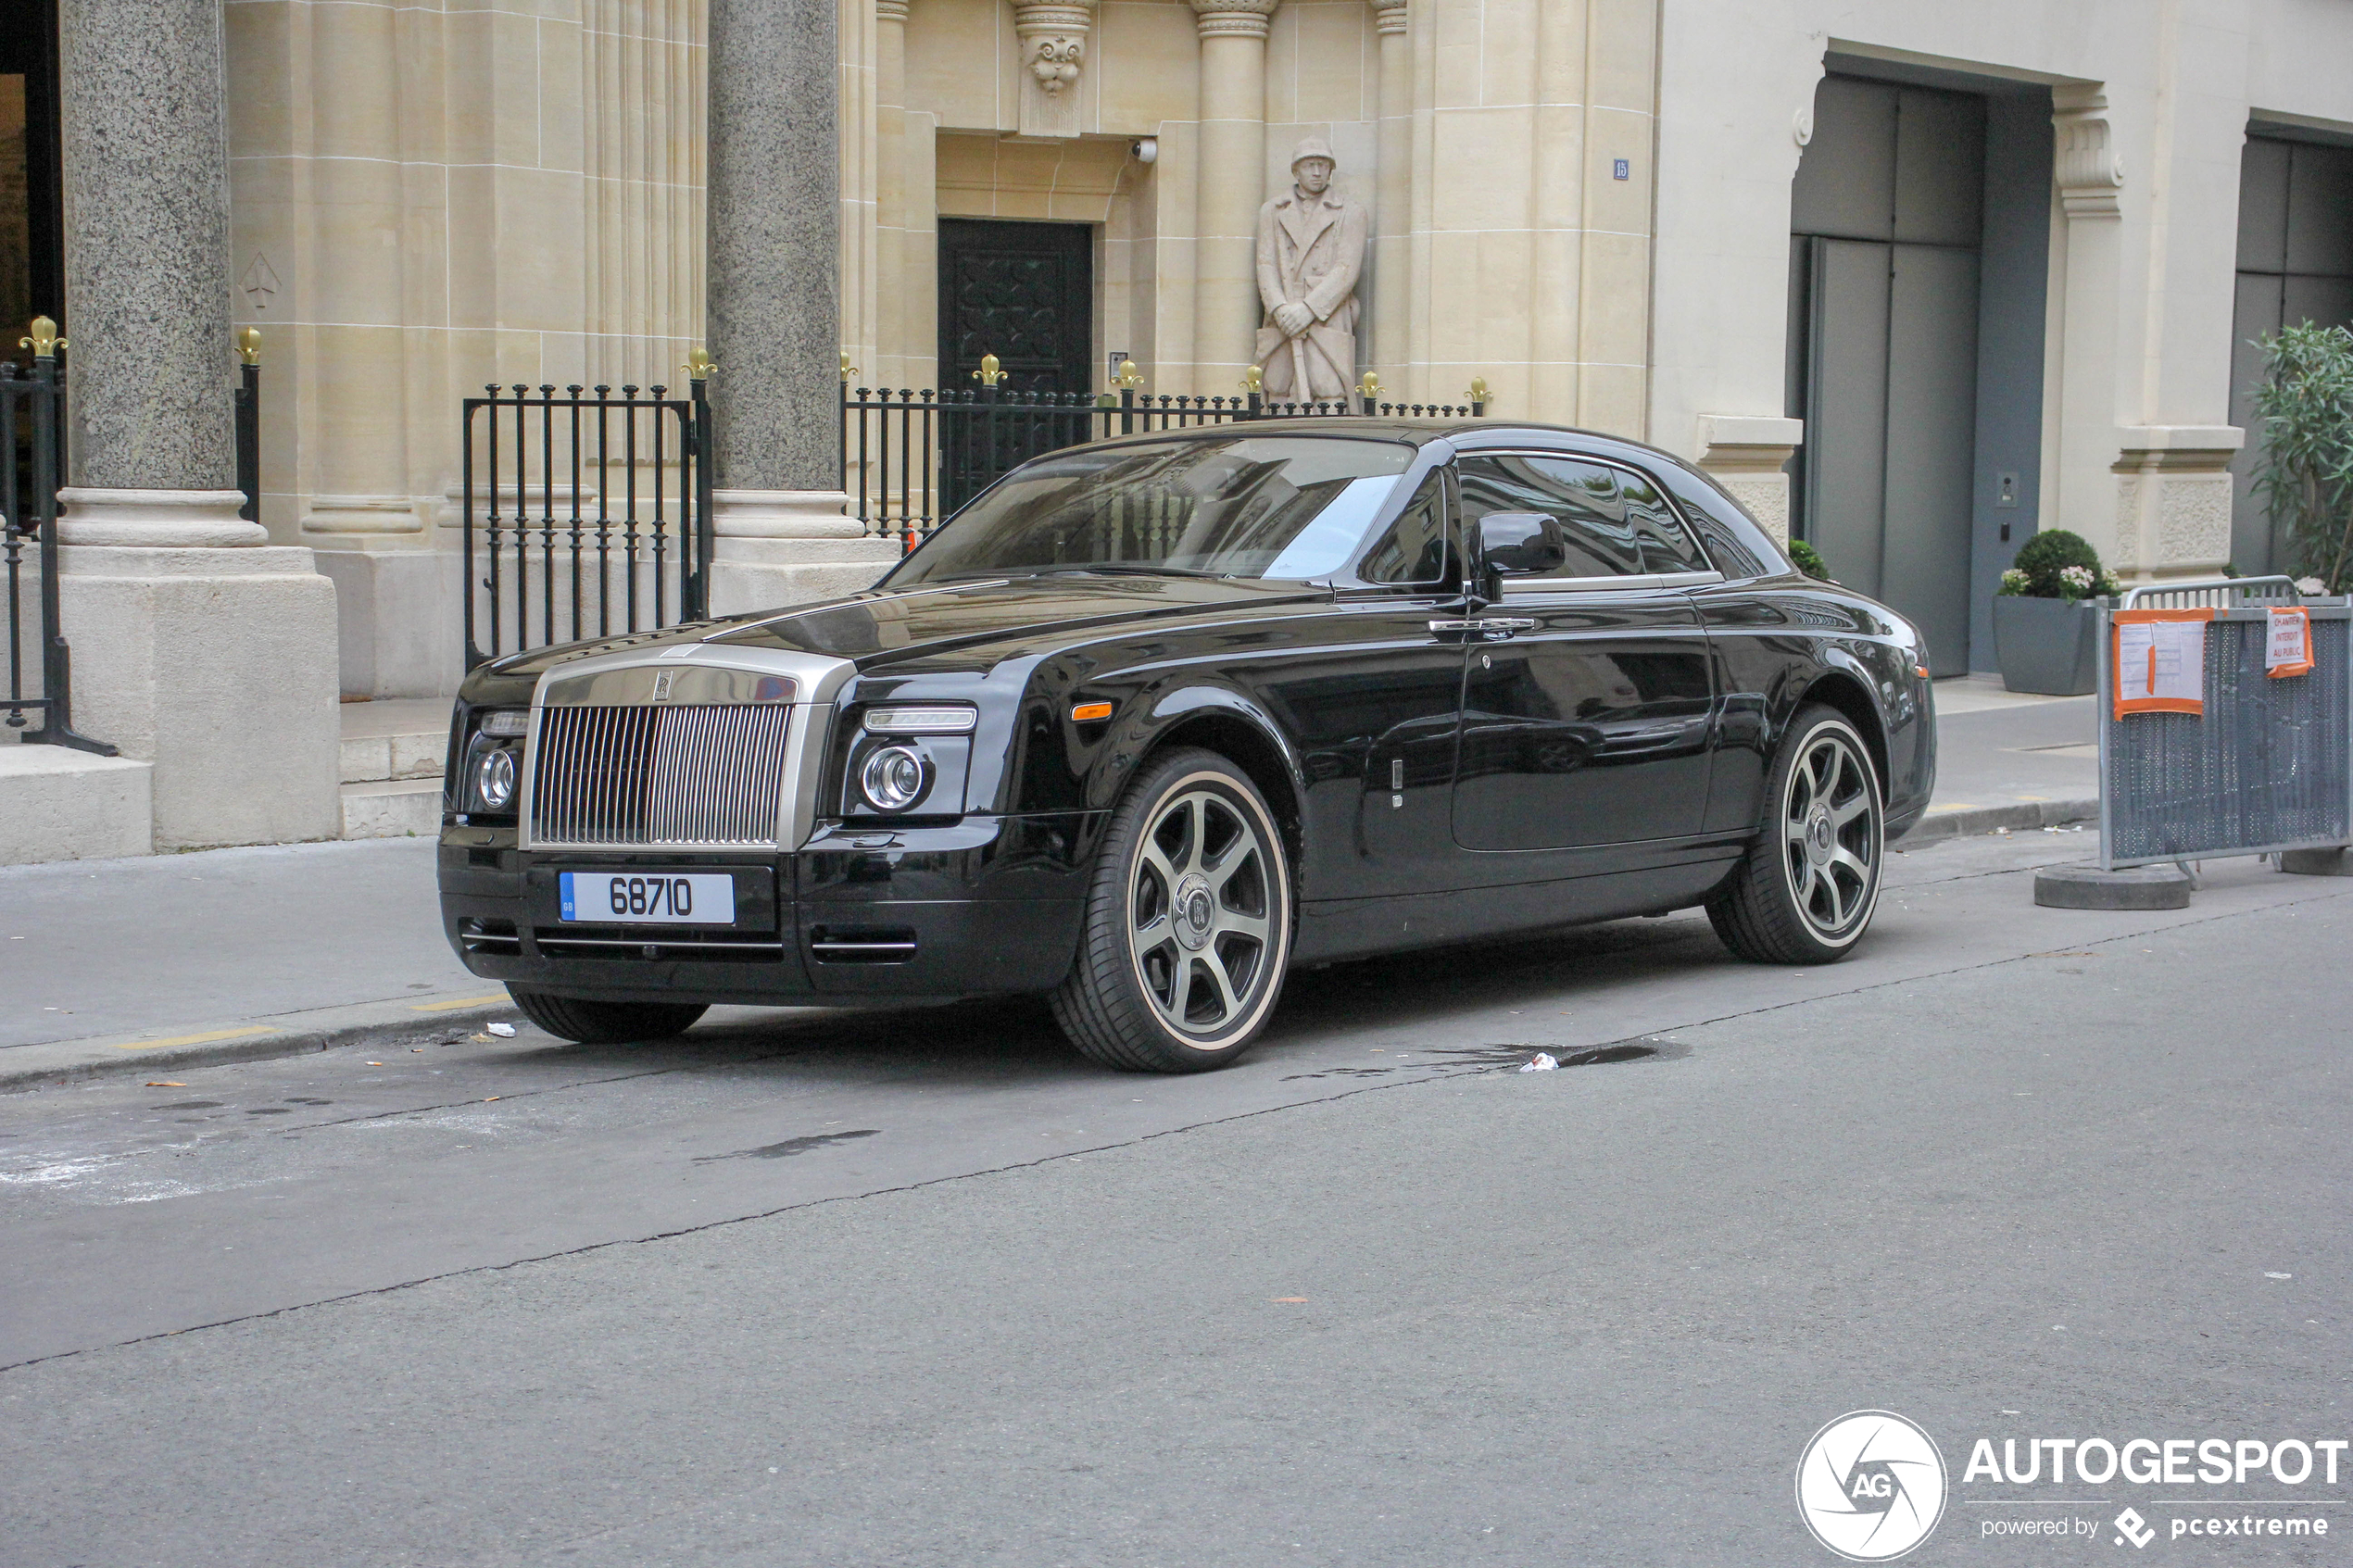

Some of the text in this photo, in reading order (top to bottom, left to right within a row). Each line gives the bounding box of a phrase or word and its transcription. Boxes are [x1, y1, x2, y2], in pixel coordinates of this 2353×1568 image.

[1617, 161, 1627, 177] 15
[2274, 616, 2299, 627] CHANTIER
[2275, 631, 2297, 641] INTERDIT
[2273, 646, 2300, 657] AU PUBLIC
[610, 877, 692, 916] 68710
[563, 902, 573, 911] GB
